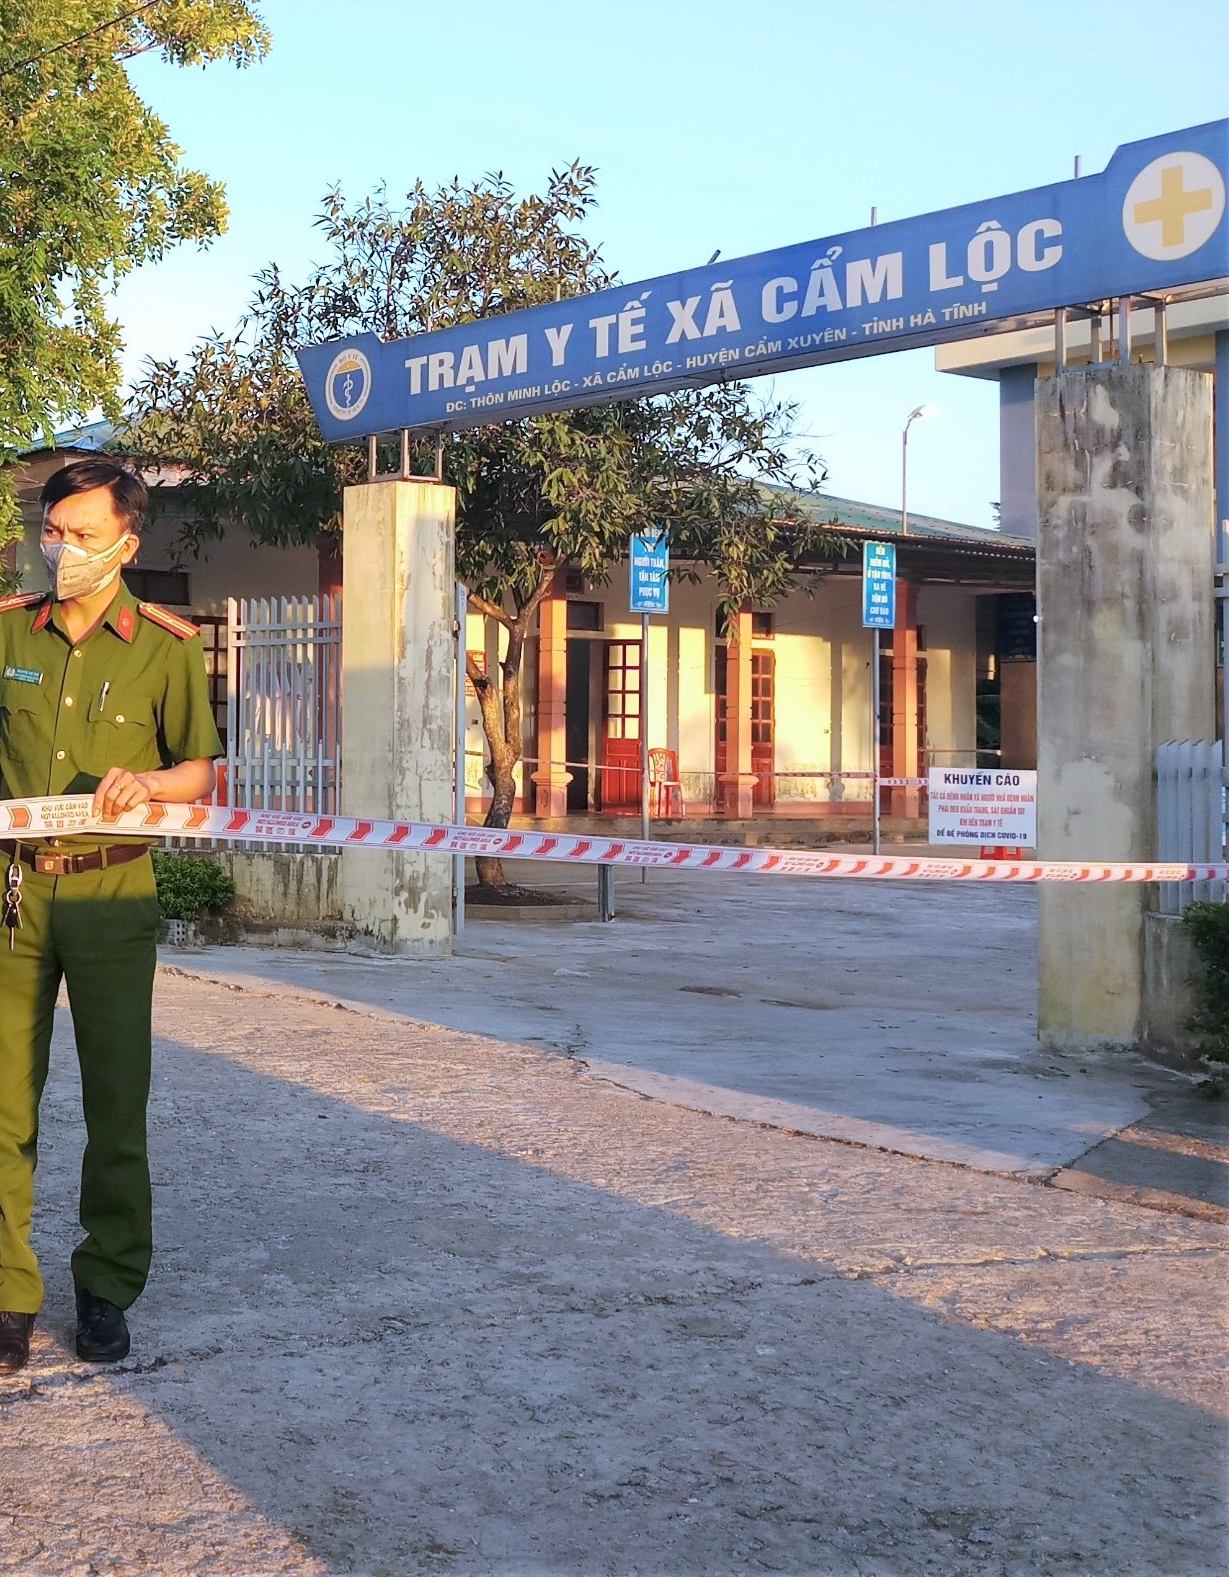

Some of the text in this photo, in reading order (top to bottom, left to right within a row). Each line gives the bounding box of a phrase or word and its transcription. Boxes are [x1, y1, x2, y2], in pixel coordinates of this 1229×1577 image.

[404, 218, 1063, 395] TRẠM Y TẾ XÃ CẨM LỘC
[446, 401, 467, 413] ĐC:
[470, 392, 504, 409] THÔN
[507, 385, 541, 402] MINH
[544, 379, 571, 398] LỘC
[582, 371, 603, 389] XÃ
[606, 362, 640, 383] CẨM
[644, 360, 673, 378] LỘC
[686, 346, 740, 369] HUYỆN
[744, 335, 782, 358] CẨM
[787, 326, 847, 349] XUYÊN
[862, 315, 904, 336] TỈNH
[909, 308, 936, 328] HÀ
[941, 301, 987, 321] TĨNH
[944, 771, 991, 786] KHUYẾN
[957, 830, 979, 838] PHÒNG
[980, 831, 996, 840] DỊCH
[997, 832, 1027, 840] COVID-19
